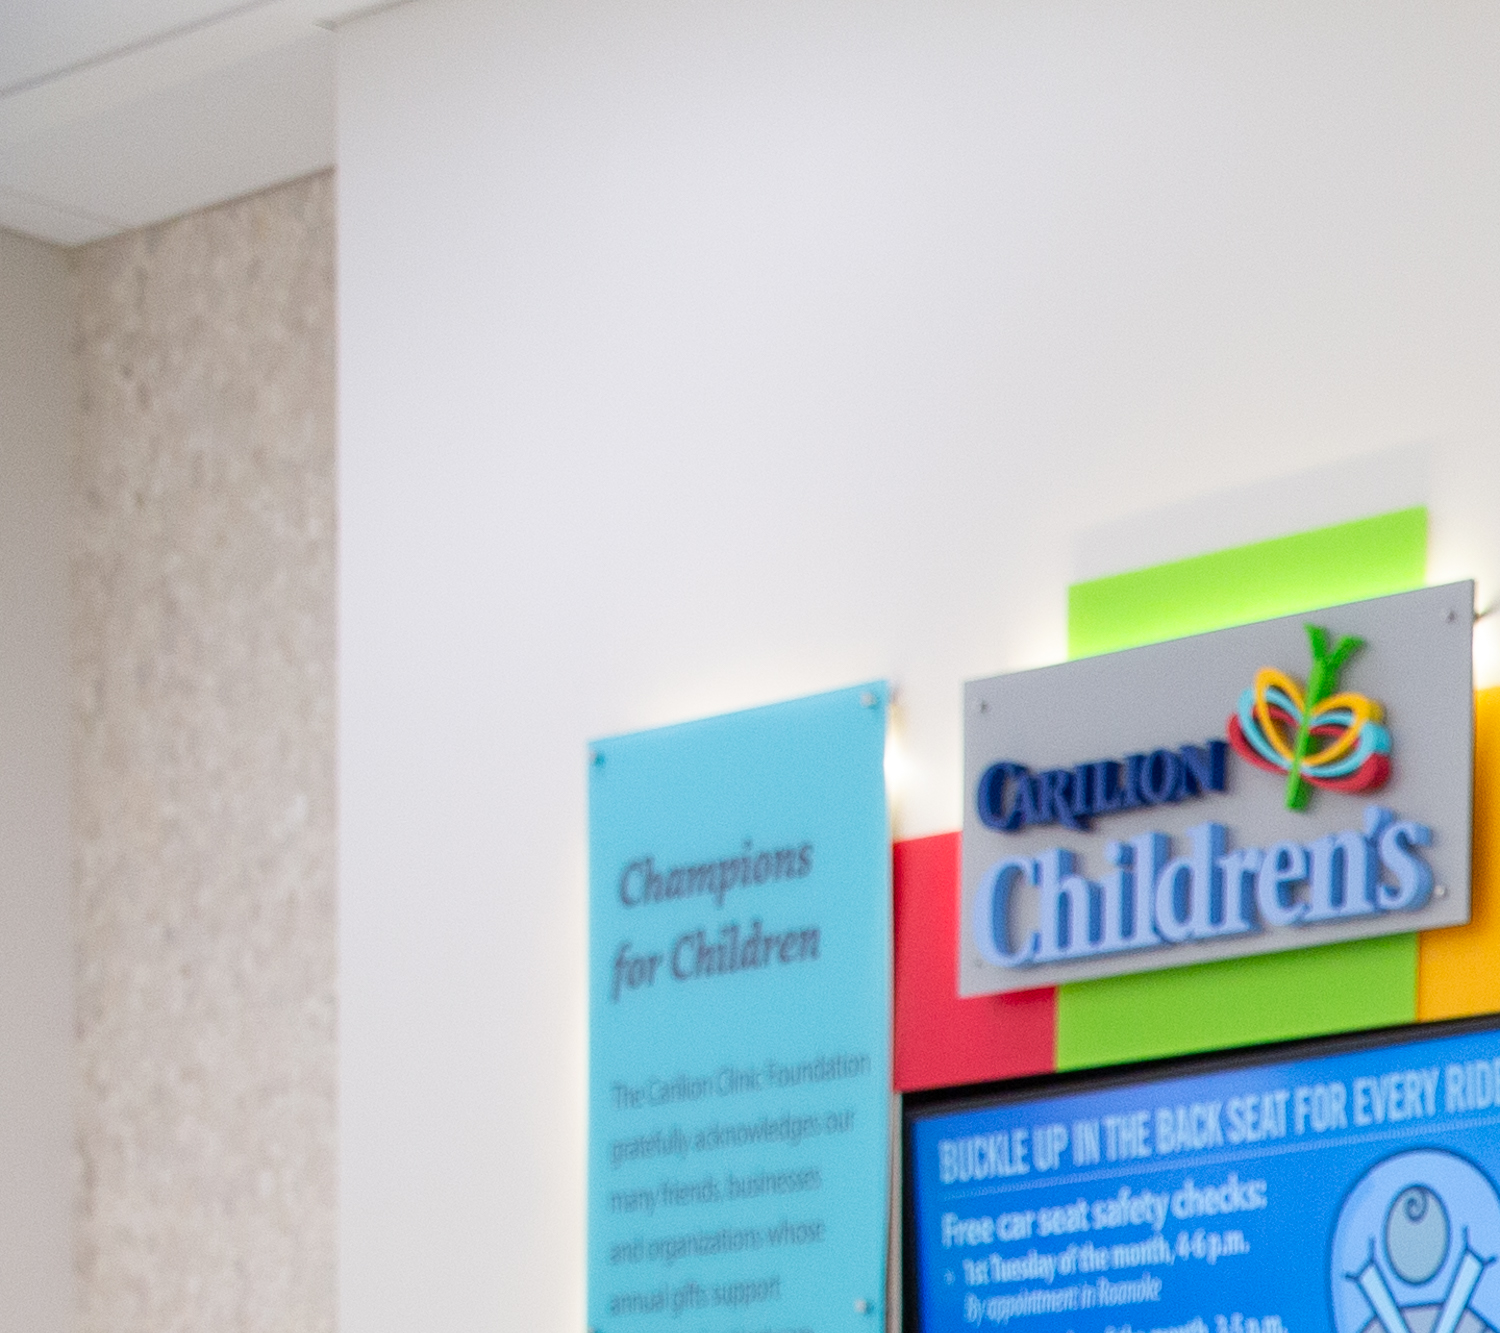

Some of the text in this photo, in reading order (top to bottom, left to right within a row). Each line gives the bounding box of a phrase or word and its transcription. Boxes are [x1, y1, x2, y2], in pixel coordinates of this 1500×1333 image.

[977, 739, 1229, 832] CARILION
[619, 840, 813, 908] Champions
[972, 806, 1433, 967] Children's
[610, 920, 821, 1003] for Children
[939, 1127, 1030, 1184] BUCKLE
[1032, 1122, 1068, 1172] UP
[1072, 1118, 1100, 1167] IN
[1102, 1110, 1152, 1161] THE
[1154, 1100, 1224, 1154] BACK
[1226, 1088, 1290, 1144] SEAT
[1294, 1080, 1348, 1136] FOR
[1353, 1067, 1441, 1127] EVERY
[941, 1171, 1268, 1248] Free car seat safety checks:
[990, 1248, 1055, 1284] Tuesday
[1057, 1243, 1077, 1275] of
[1078, 1240, 1109, 1273] the
[1112, 1232, 1175, 1269] month,
